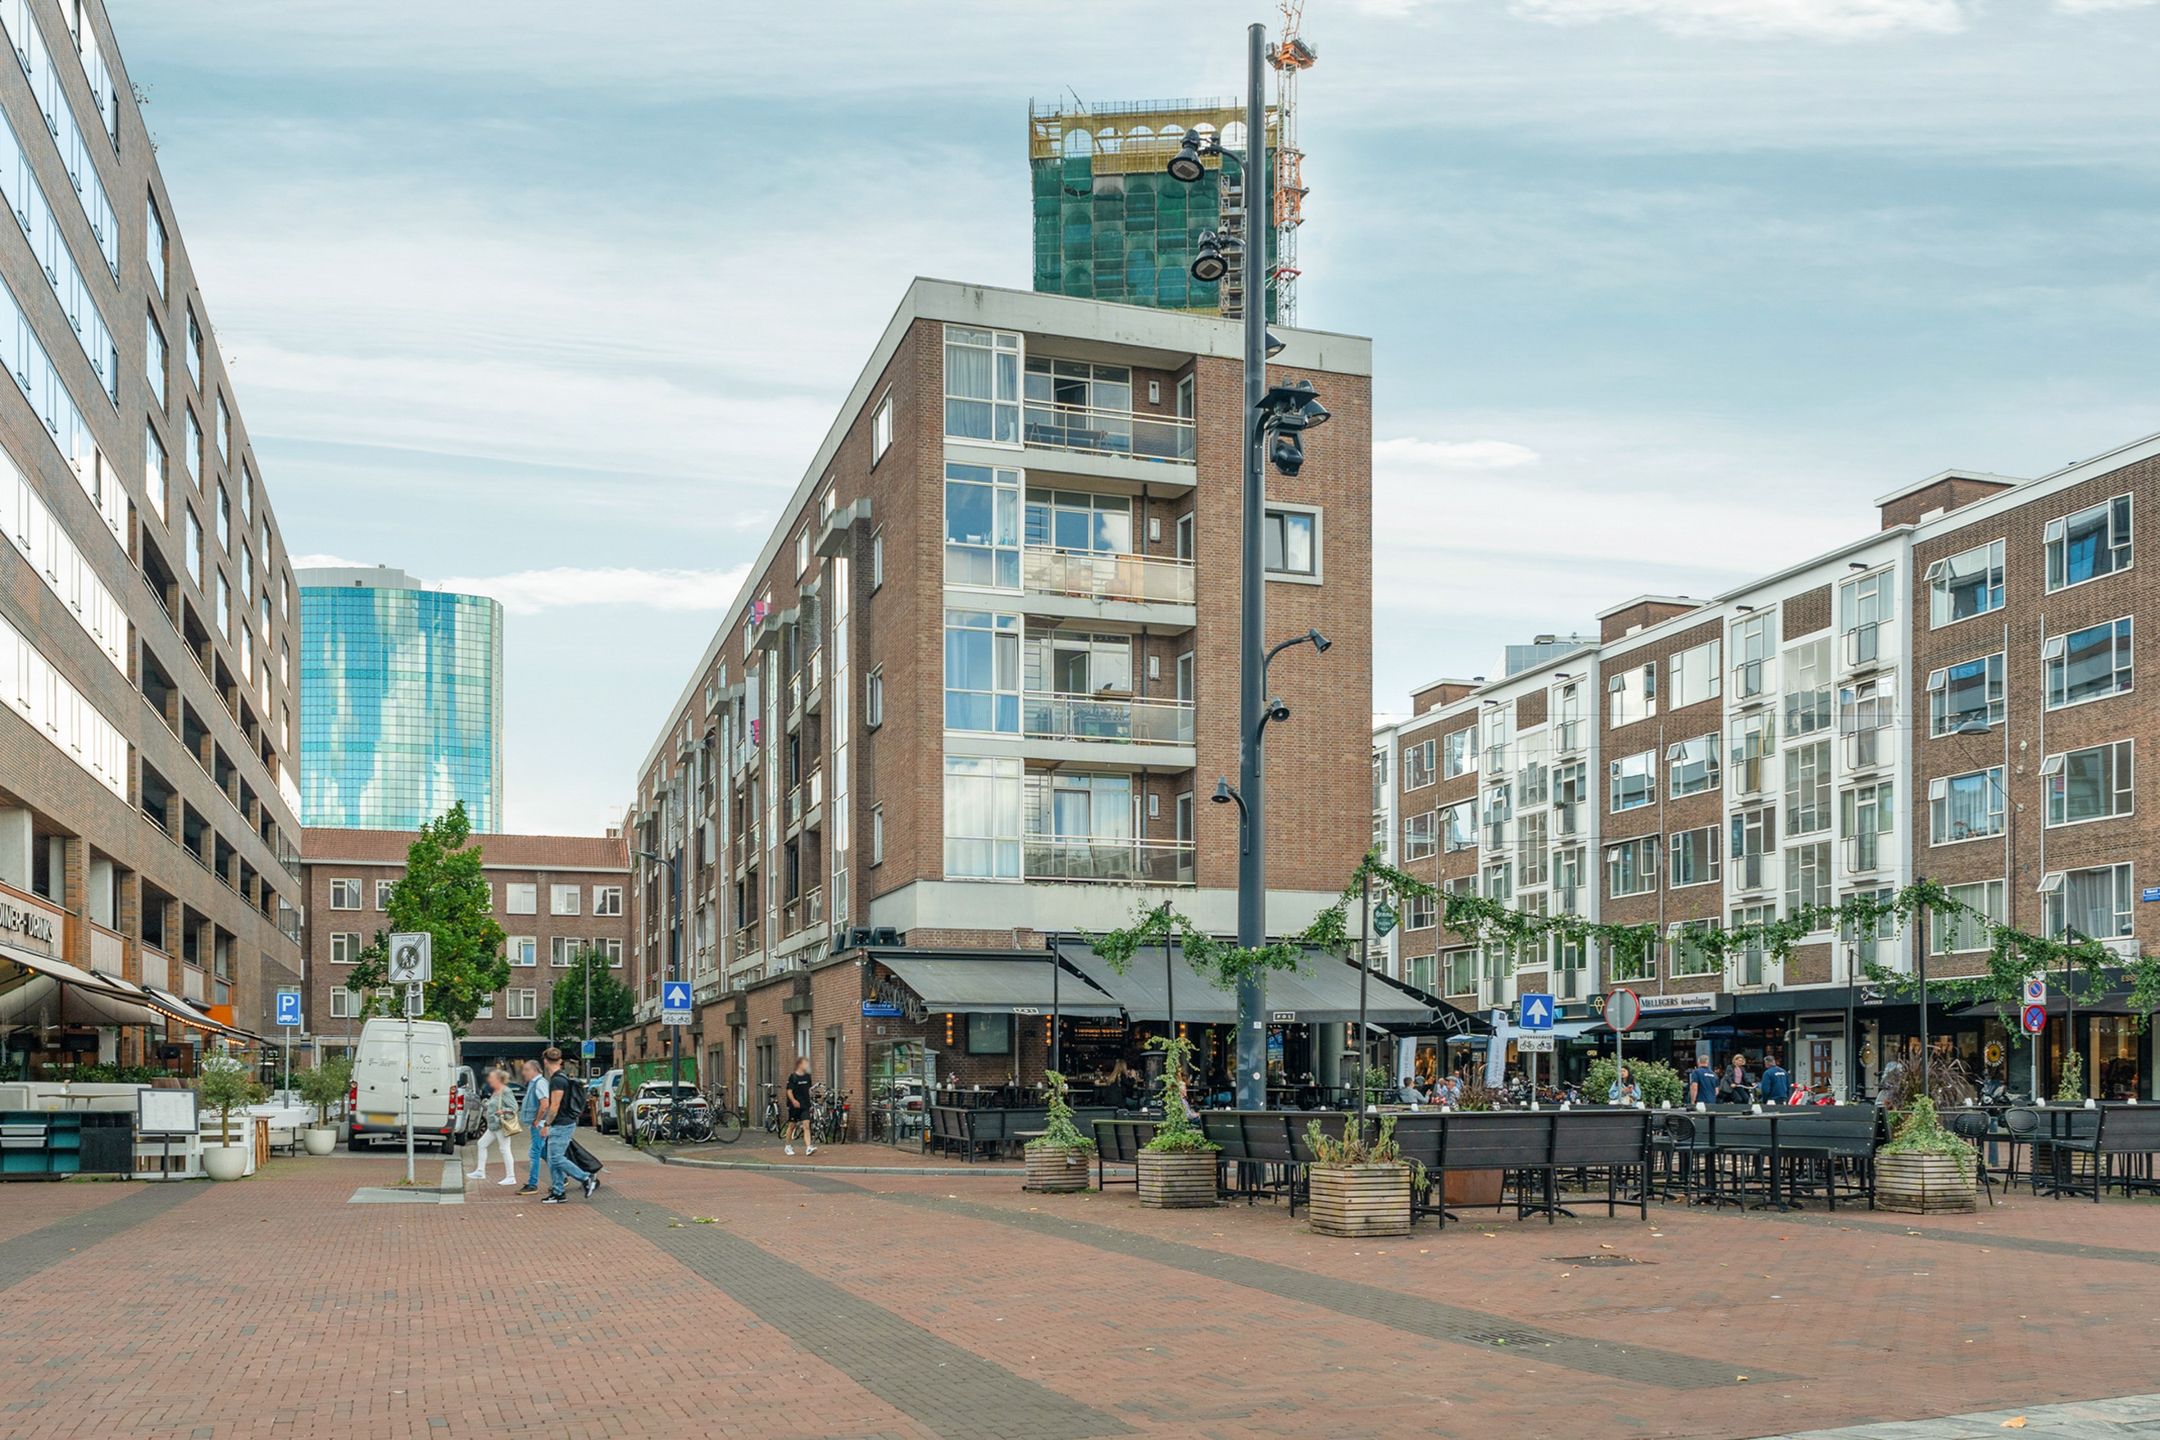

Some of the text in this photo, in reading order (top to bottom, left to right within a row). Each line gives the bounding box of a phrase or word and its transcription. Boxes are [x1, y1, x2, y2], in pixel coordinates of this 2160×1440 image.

[28, 914, 54, 943] DRINKS
[282, 995, 295, 1011] P
[1641, 998, 1678, 1008] MELLEGERS
